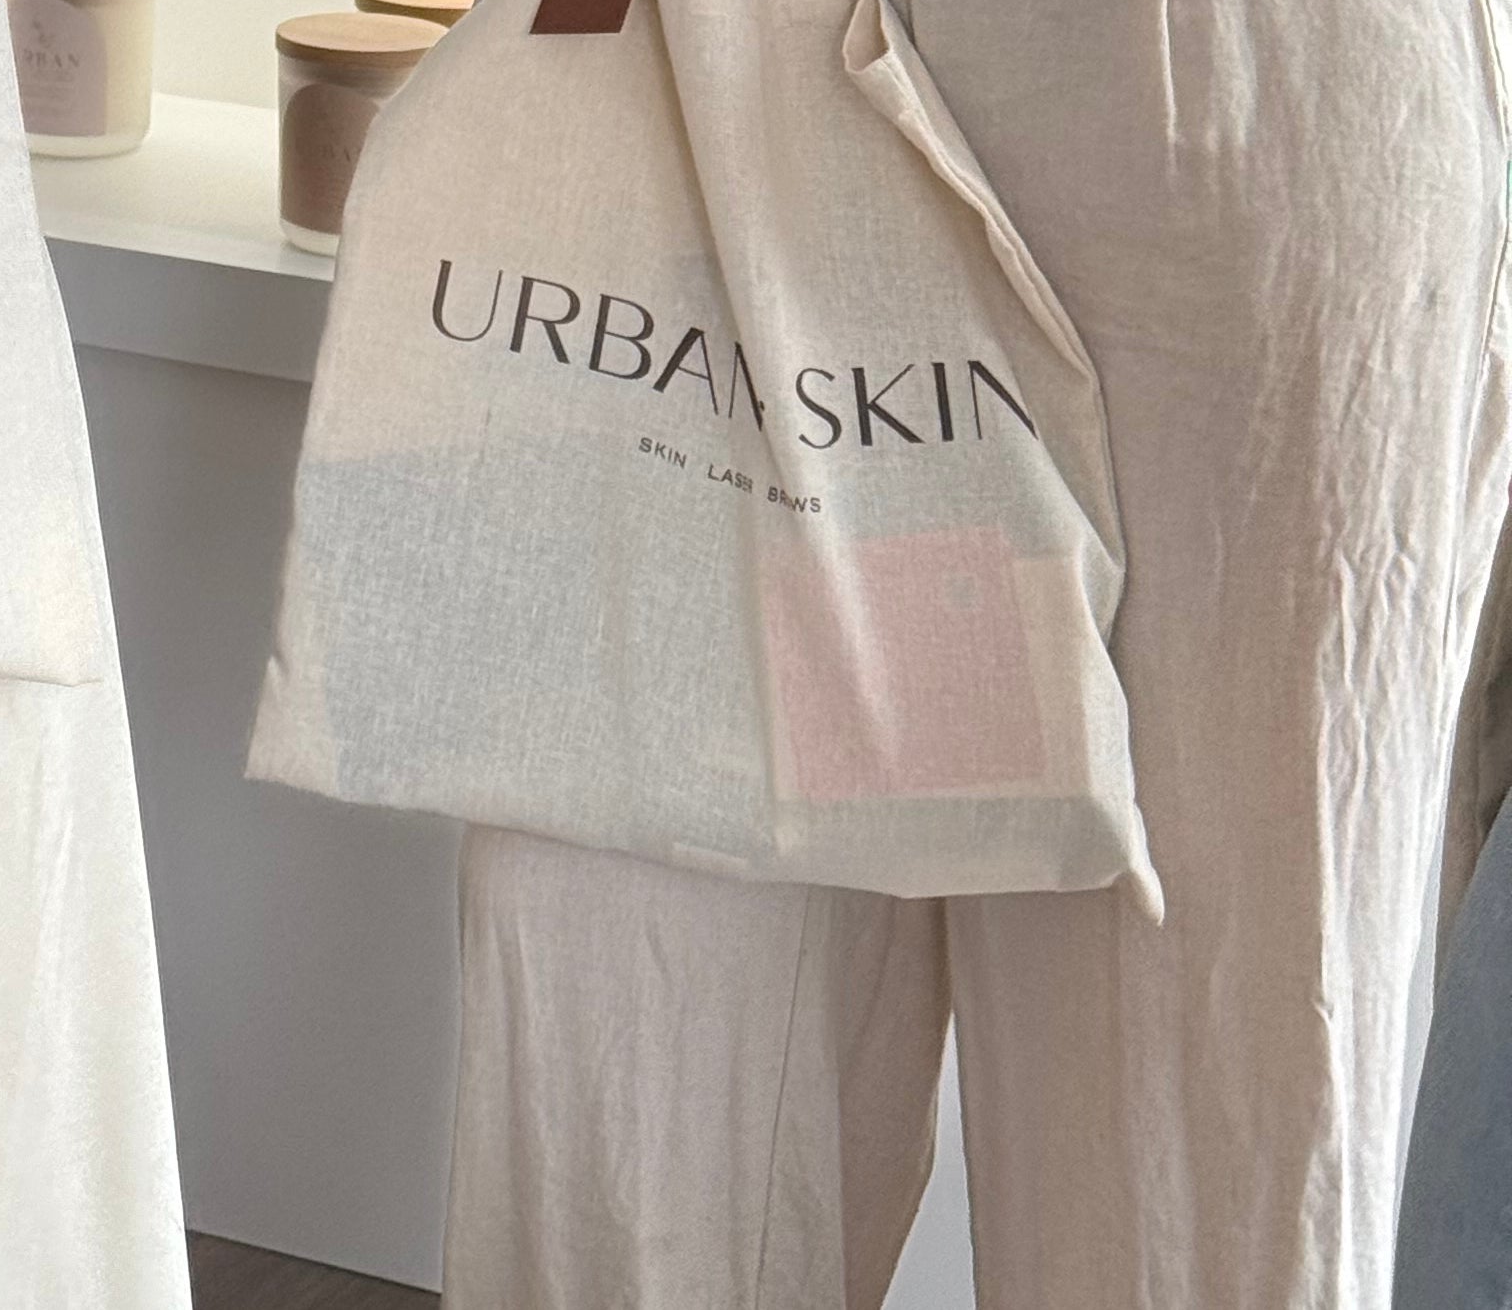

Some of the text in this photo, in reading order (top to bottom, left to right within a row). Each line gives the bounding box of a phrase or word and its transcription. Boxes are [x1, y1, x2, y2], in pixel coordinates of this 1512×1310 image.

[432, 259, 1040, 450] URBAN SKIN
[638, 436, 687, 469] SKIN
